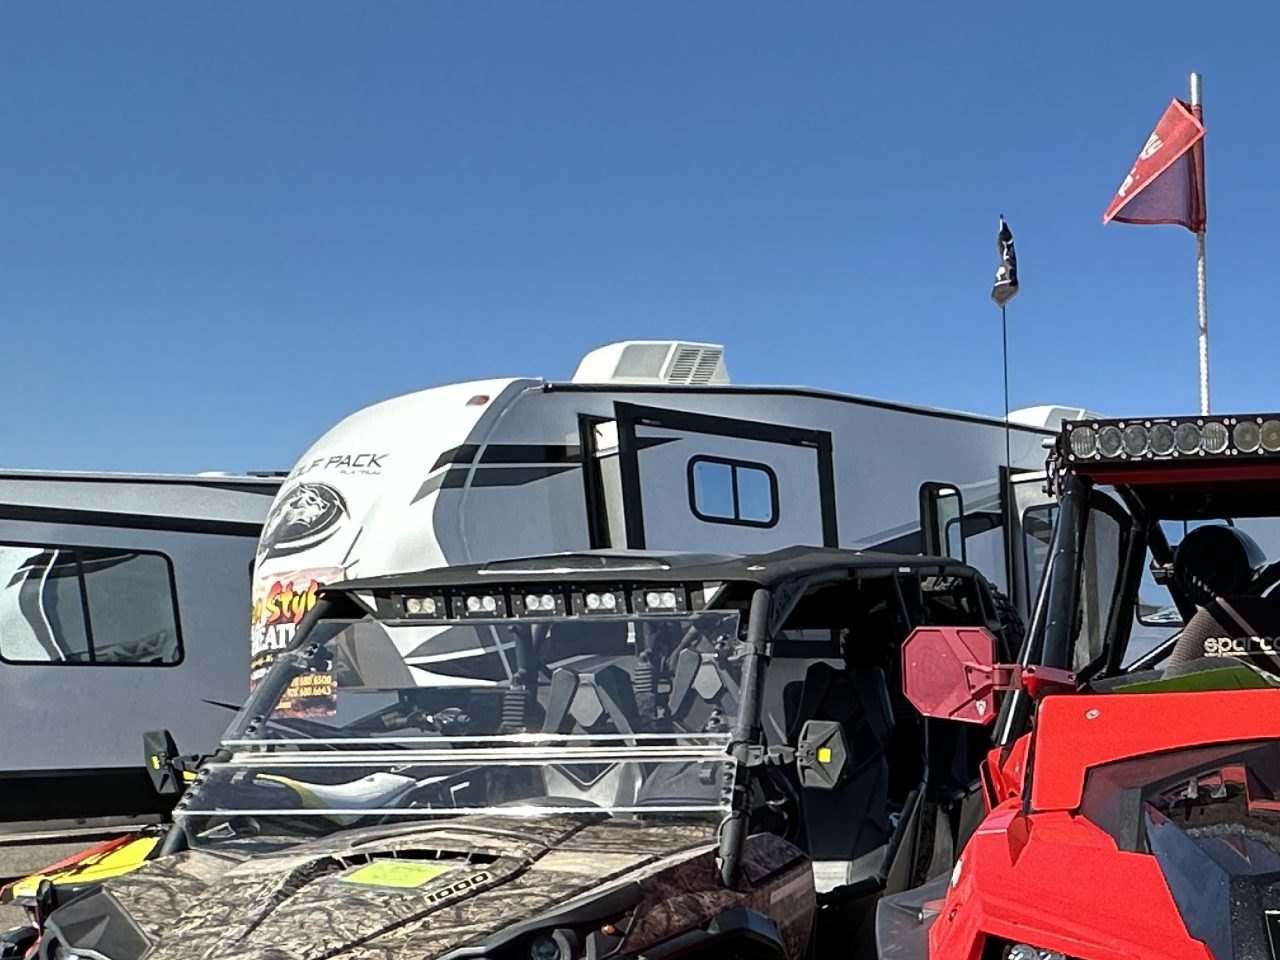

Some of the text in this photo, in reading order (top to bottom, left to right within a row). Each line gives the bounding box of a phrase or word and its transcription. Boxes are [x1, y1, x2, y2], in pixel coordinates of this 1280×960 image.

[324, 453, 390, 470] PACK
[266, 579, 319, 625] Styl
[425, 871, 490, 904] 1000
